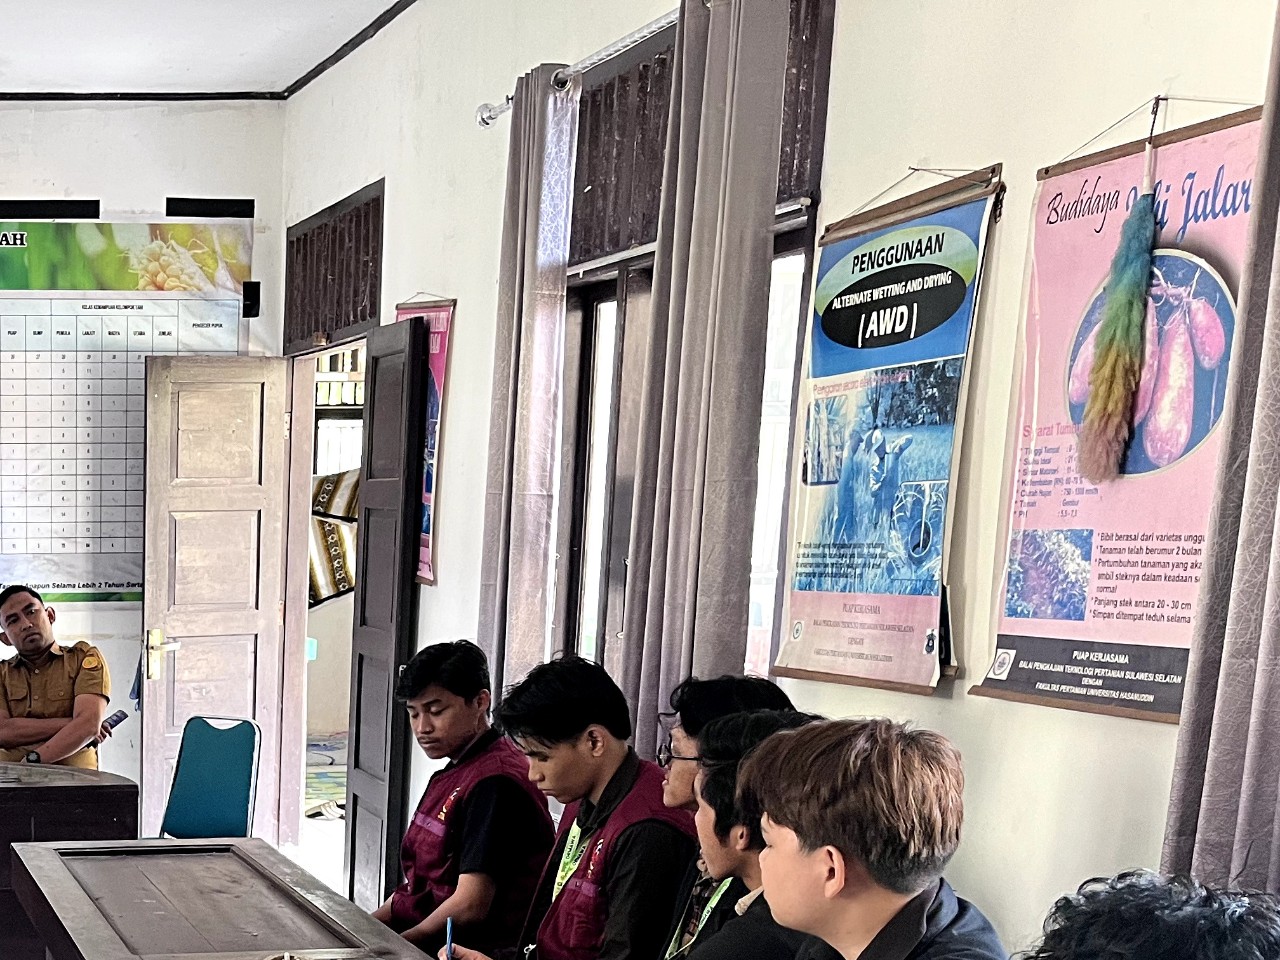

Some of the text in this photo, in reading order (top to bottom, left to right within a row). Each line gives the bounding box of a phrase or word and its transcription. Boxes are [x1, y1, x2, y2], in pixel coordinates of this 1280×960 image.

[1046, 176, 1120, 234] Budidaya
[1176, 164, 1252, 244] Jalar
[851, 232, 945, 274] PENGGUNAAN
[832, 271, 952, 310] ALTERNATE WETTING AND DRYING
[1115, 533, 1139, 541] berasal
[1140, 533, 1153, 541] dari
[1156, 533, 1182, 541] varietas
[1100, 546, 1201, 555] Tanaman telah berumur 2 bulan
[1141, 560, 1170, 568] tanaman
[1171, 562, 1188, 571] yang
[1115, 573, 1139, 583] steknya
[1142, 573, 1162, 581] dalam
[1164, 573, 1192, 582] keadaan
[1094, 597, 1117, 608] Panjang
[1119, 598, 1132, 607] stek
[1134, 600, 1155, 608] antara
[1157, 600, 1165, 608] 20
[1171, 600, 1179, 609] 30
[1093, 610, 1191, 623] Simpan ditempat teduh selama
[1072, 651, 1129, 664] PUAP KERJASAMA
[1019, 661, 1033, 669] BALAI
[1065, 665, 1094, 675] TEKNOLOGI
[1094, 668, 1124, 678] PERTANIAN
[1125, 671, 1154, 681] SULAWESI
[1154, 674, 1182, 684] SELATAN
[1082, 677, 1103, 686] DENGAN
[1087, 688, 1120, 698] UNIVERSITAS
